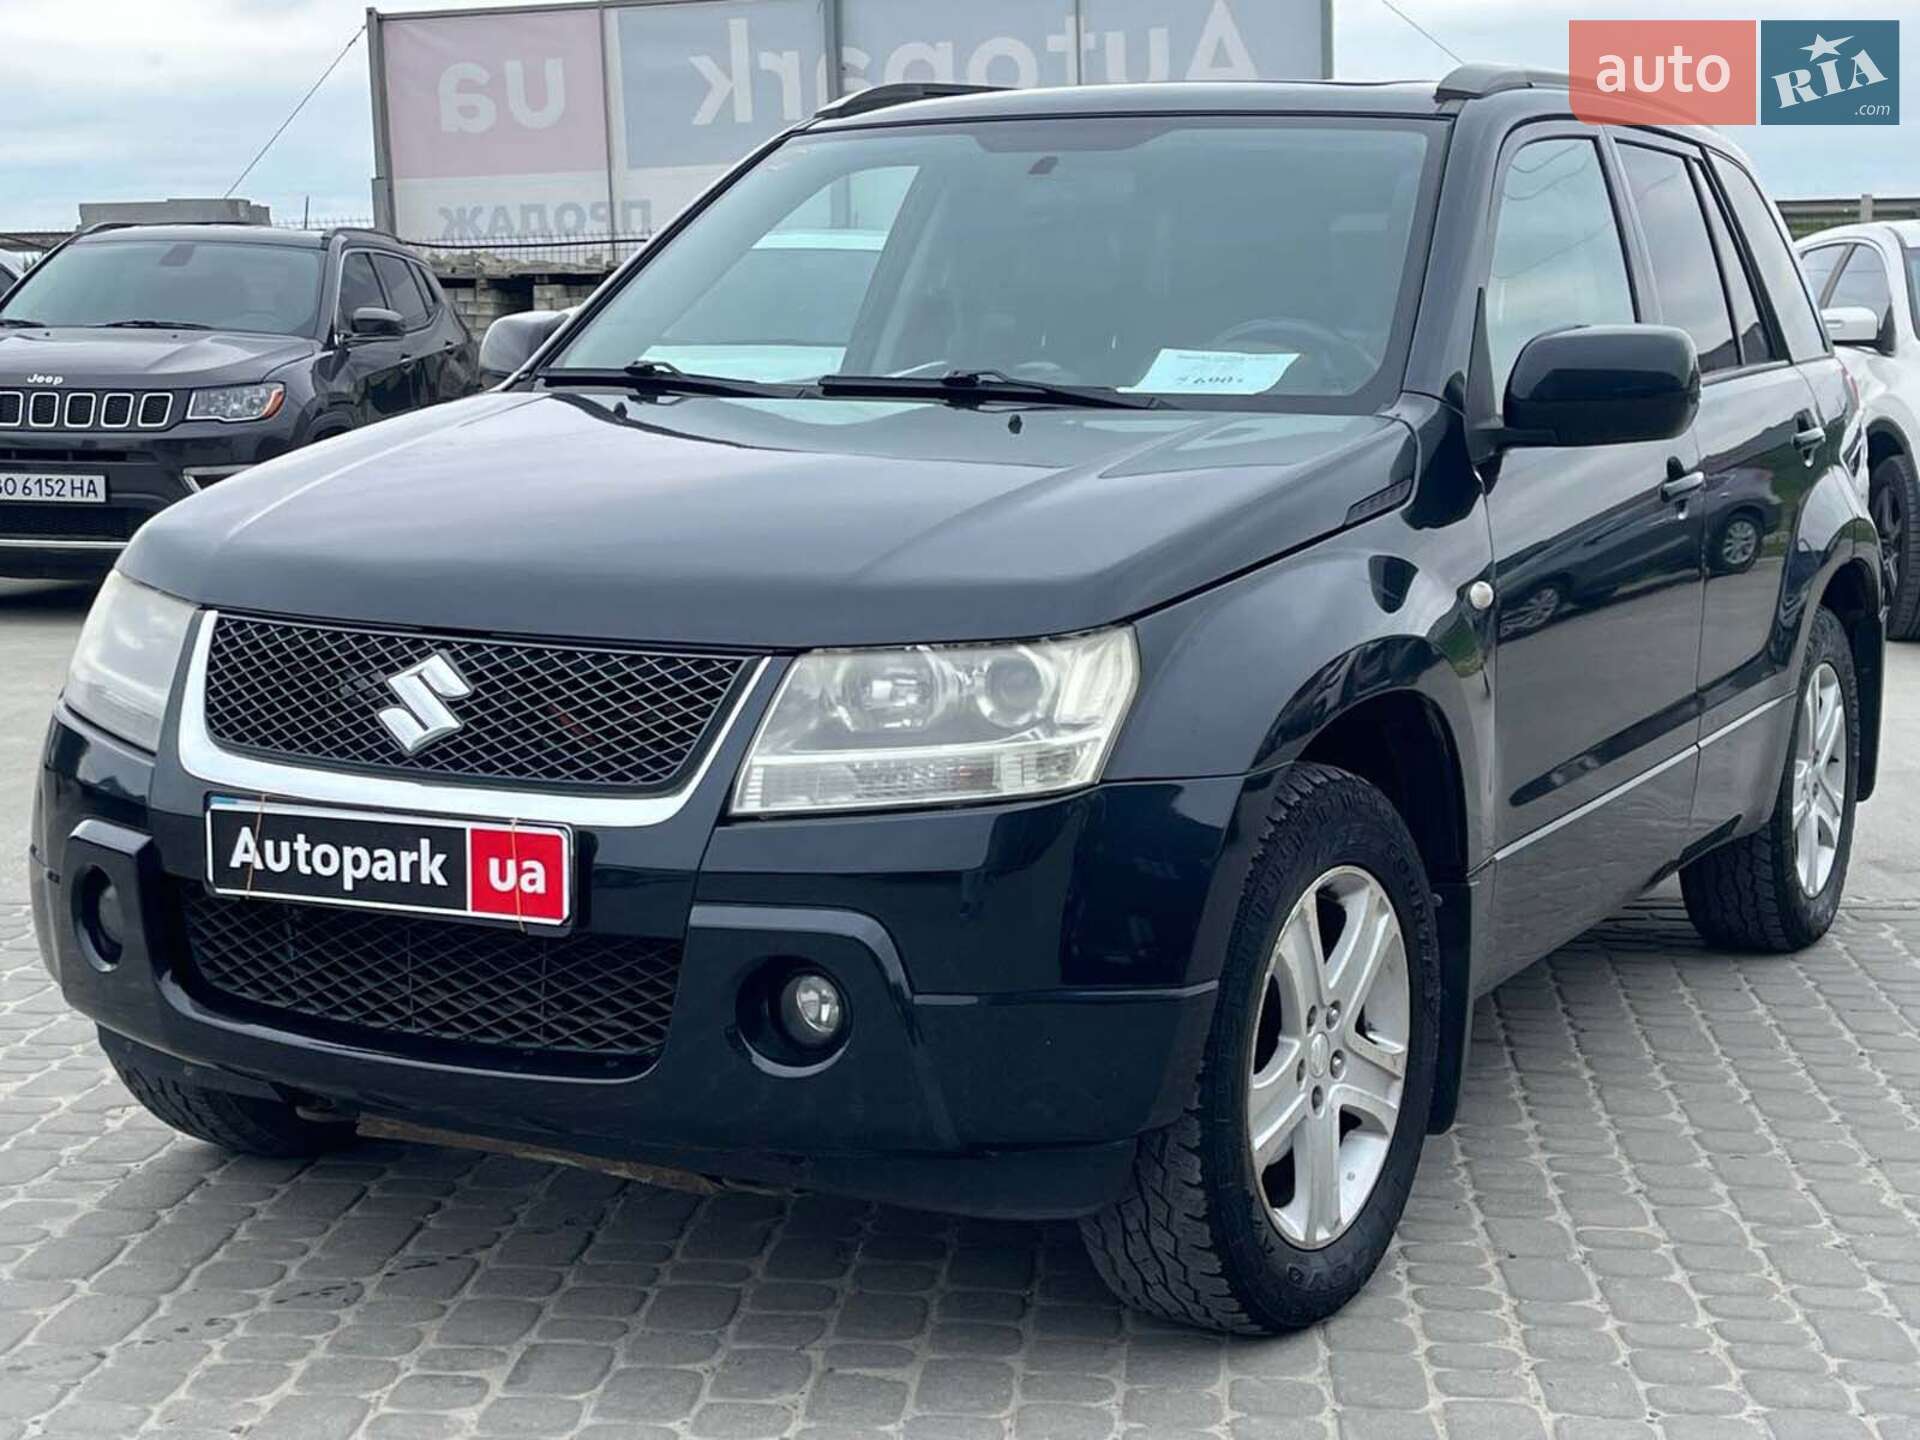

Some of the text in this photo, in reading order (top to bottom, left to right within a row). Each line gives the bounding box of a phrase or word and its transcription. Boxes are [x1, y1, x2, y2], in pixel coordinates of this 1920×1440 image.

[26, 373, 64, 386] Jeep
[0, 477, 98, 498] O 6152 HA
[229, 826, 547, 895] Autopark ua
